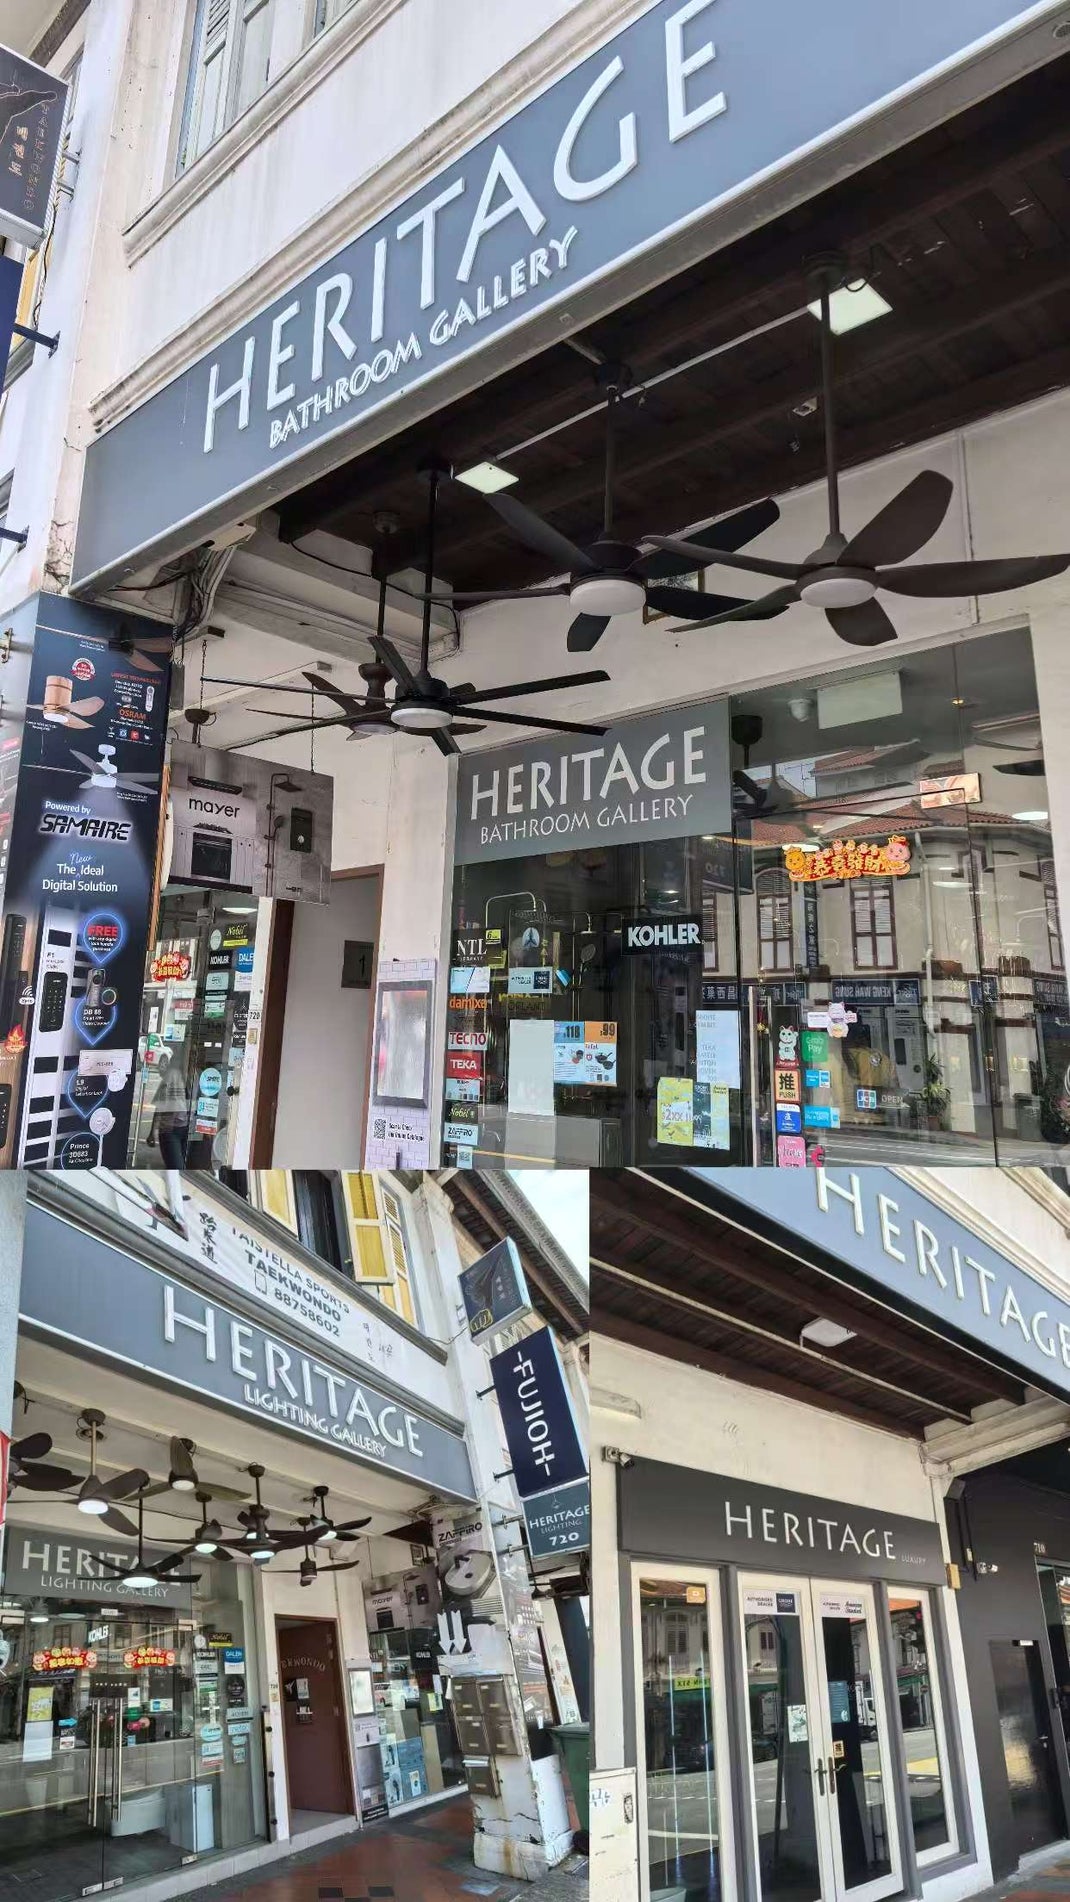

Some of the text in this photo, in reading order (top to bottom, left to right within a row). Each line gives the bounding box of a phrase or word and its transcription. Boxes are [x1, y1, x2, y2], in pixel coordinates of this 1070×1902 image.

[203, 0, 728, 453] HERITAGE
[269, 225, 579, 450] BATHROOM GALLERY
[119, 709, 146, 720] OSRAM
[471, 726, 707, 821] HERITAGE
[45, 801, 91, 815] Powered by
[189, 798, 240, 818] mayer
[40, 814, 132, 841] SAMAIRE
[481, 794, 693, 844] BATHROOM GALLERY
[70, 852, 94, 864] New
[57, 864, 104, 876] The Ideal
[42, 879, 118, 893] Digital Solution
[628, 923, 701, 947] KOHLER
[457, 939, 487, 956] NTL
[210, 955, 230, 964] KOHLER
[450, 995, 487, 1010] damixa
[449, 1032, 487, 1046] TECNO
[808, 1044, 823, 1054] Pay
[450, 1059, 477, 1070] TEKA
[779, 1073, 795, 1091] 推
[816, 1167, 1070, 1369] HERITAGE
[245, 1249, 341, 1322] TAEKWONDO
[274, 1282, 340, 1337] 88758602
[163, 1285, 424, 1458] HERITAGE
[243, 1383, 388, 1459] LIGHTING GALLERY
[513, 1351, 555, 1477] FUJIOH
[529, 1505, 590, 1529] HERITAGE
[541, 1519, 582, 1535] LIGHTING
[725, 1501, 896, 1560] HERITAGE
[549, 1532, 580, 1546] 720
[41, 1575, 112, 1593] LIGHTING
